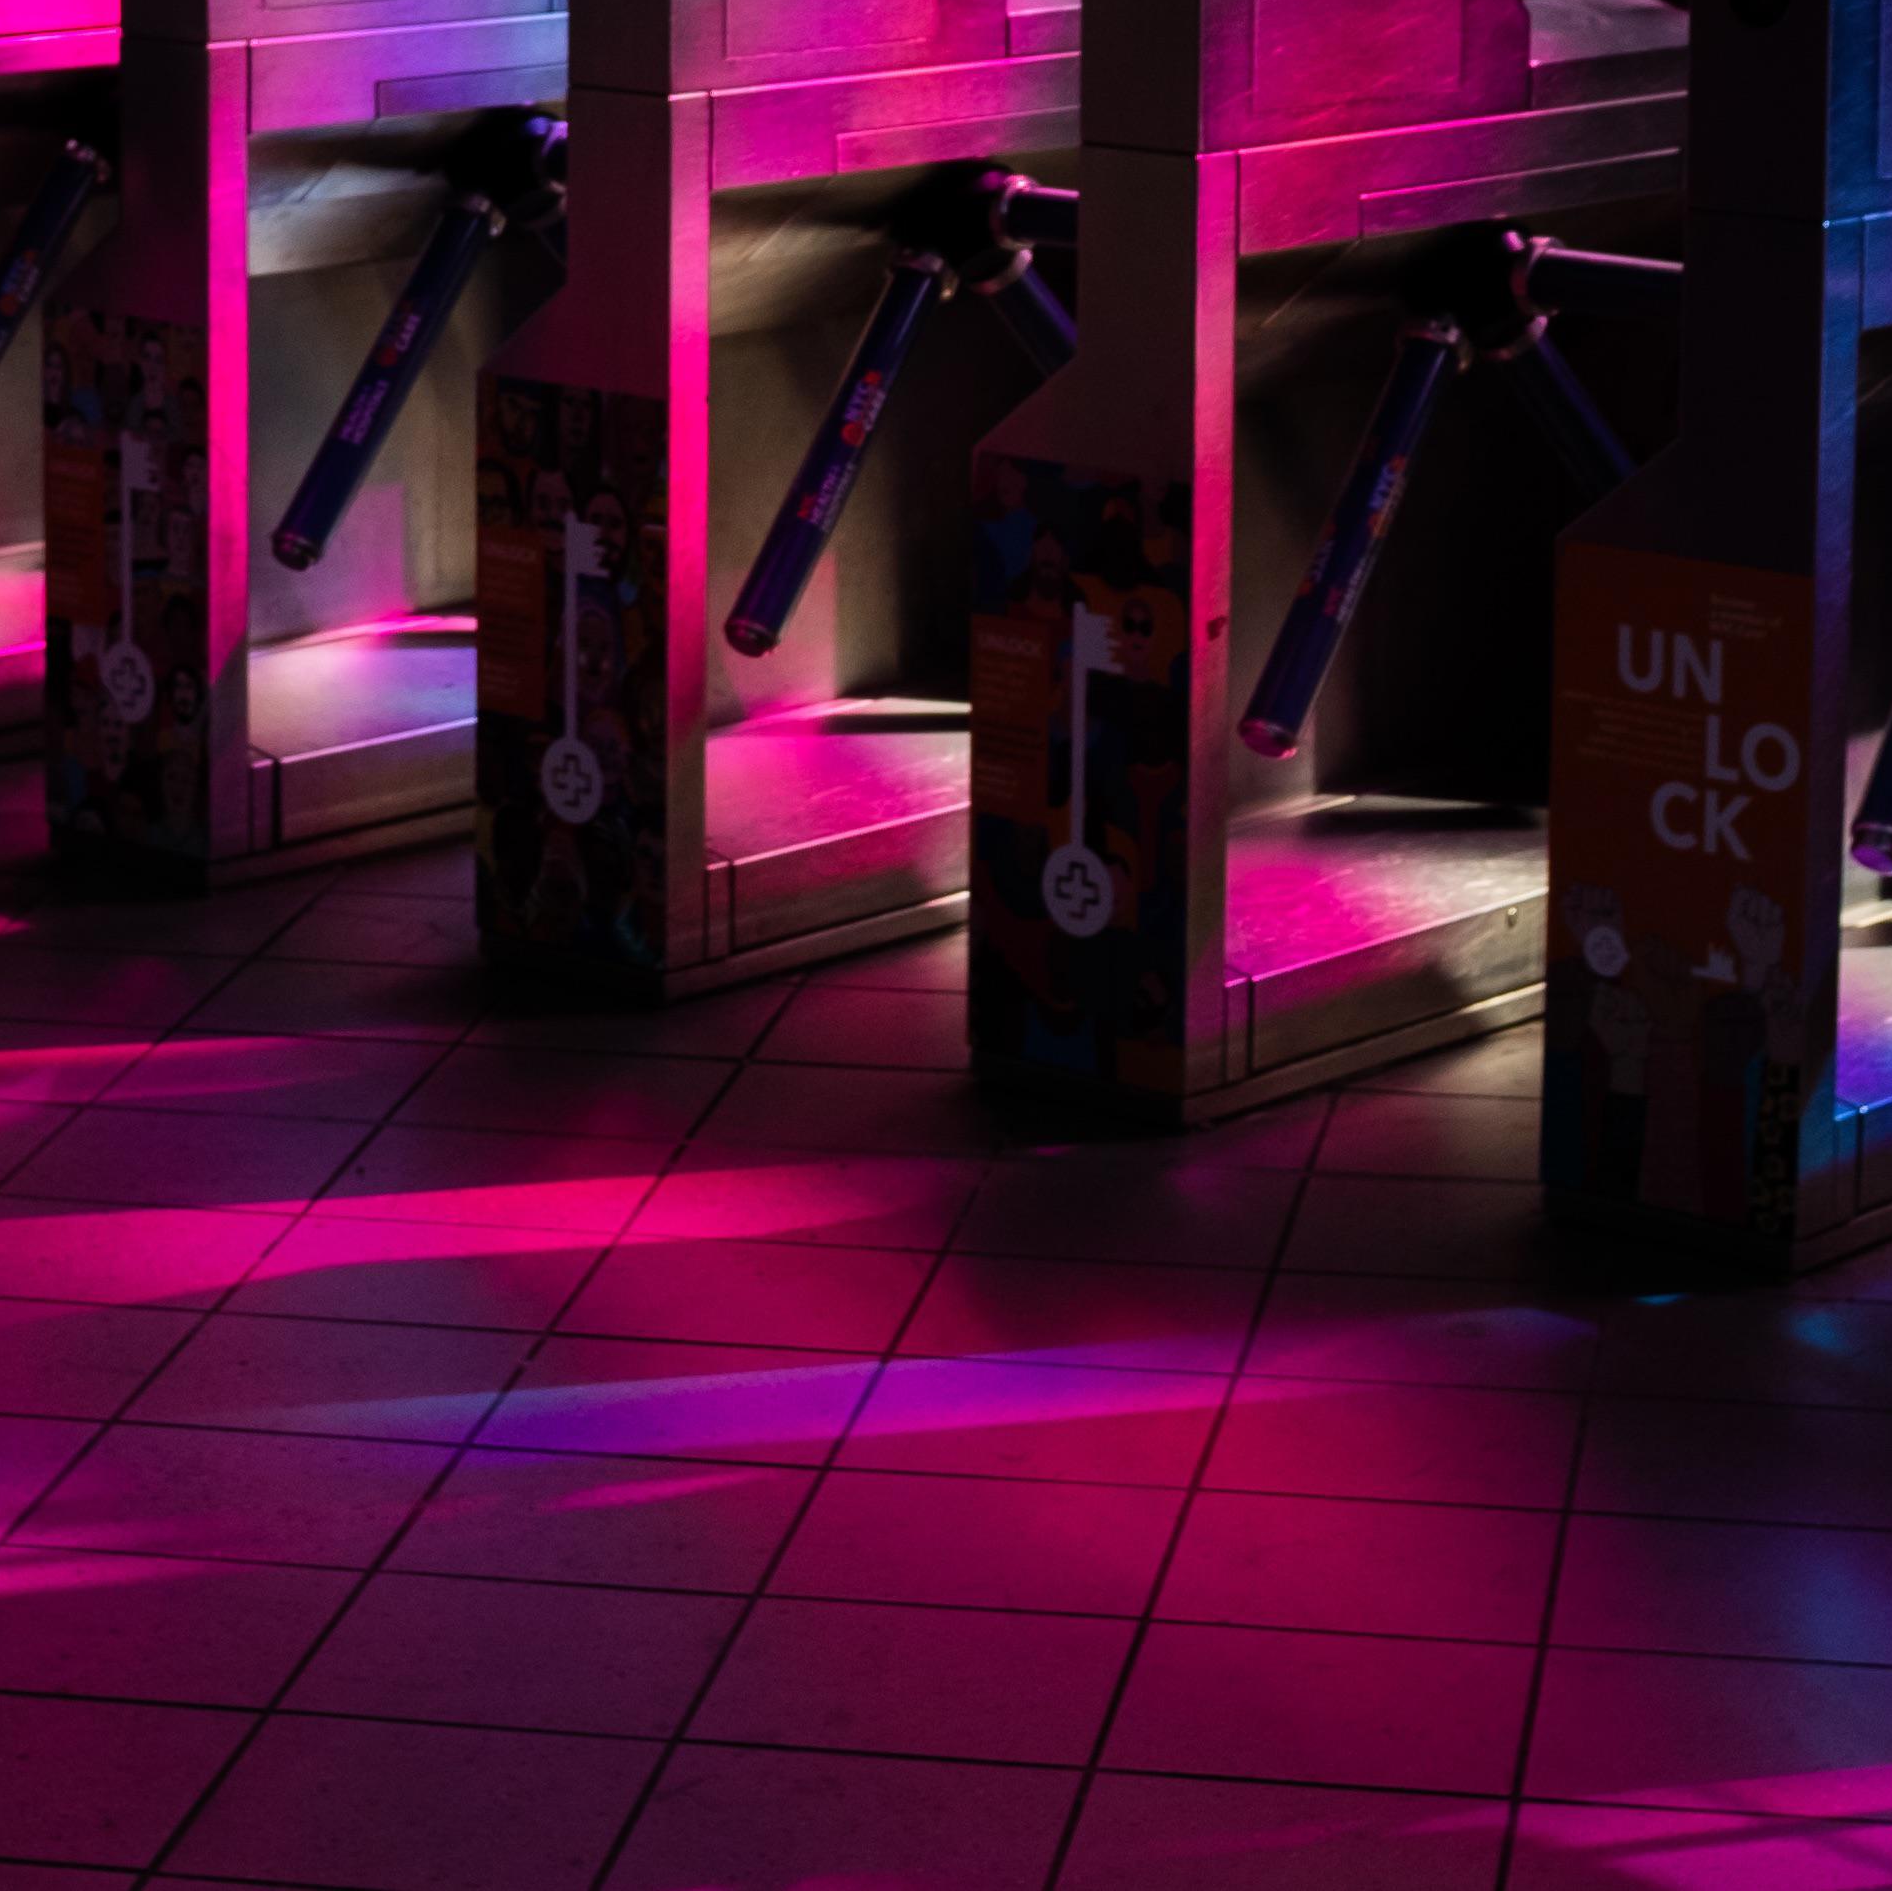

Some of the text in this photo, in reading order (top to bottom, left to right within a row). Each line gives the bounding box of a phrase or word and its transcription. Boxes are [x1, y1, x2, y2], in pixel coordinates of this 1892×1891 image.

[1617, 622, 1724, 705] UN
[1704, 713, 1802, 793] LO
[1650, 780, 1754, 861] CK
